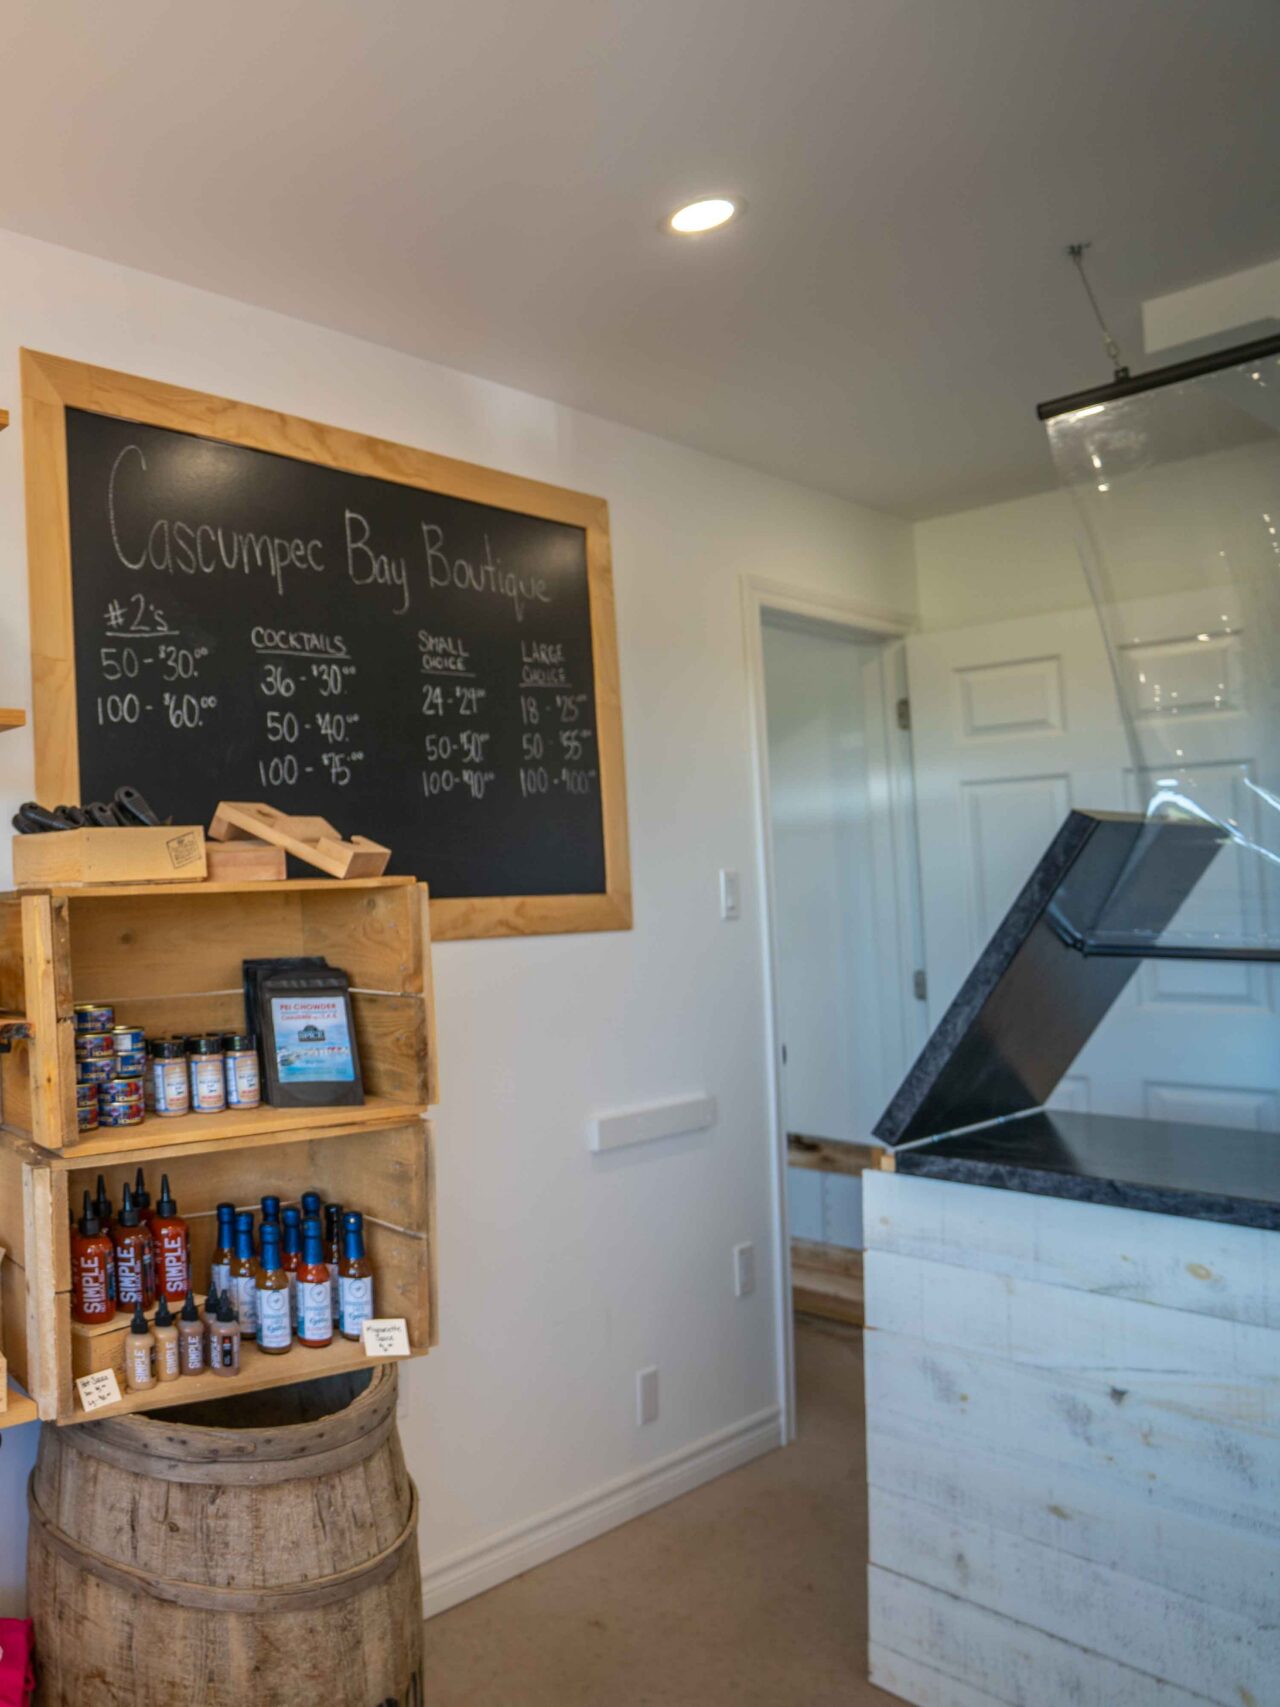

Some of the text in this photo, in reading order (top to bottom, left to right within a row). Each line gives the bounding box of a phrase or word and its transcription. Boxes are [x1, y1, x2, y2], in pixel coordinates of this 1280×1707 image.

[108, 444, 552, 621] Cascumpec Bay Boutique
[251, 626, 348, 655] COCKTAILS
[417, 629, 470, 658] SMALL
[520, 640, 565, 665] LARGE
[100, 647, 139, 681] 50
[422, 653, 467, 672] CHOICE
[521, 665, 567, 683] CHOICE
[260, 664, 296, 698] 36
[97, 692, 141, 726] 100
[421, 683, 444, 717] 24
[520, 695, 540, 725] 18
[266, 710, 300, 744] 50
[424, 734, 452, 762] 50
[521, 732, 544, 761] 50
[258, 754, 300, 788] 100
[422, 769, 454, 798] 100
[520, 766, 549, 798] 100
[117, 1246, 137, 1303] SIMPLE
[164, 1236, 184, 1293] SIMPLE
[81, 1256, 101, 1314] SIMPLE
[134, 1348, 146, 1383] SIMPLE
[188, 1335, 200, 1369] SIMPLE
